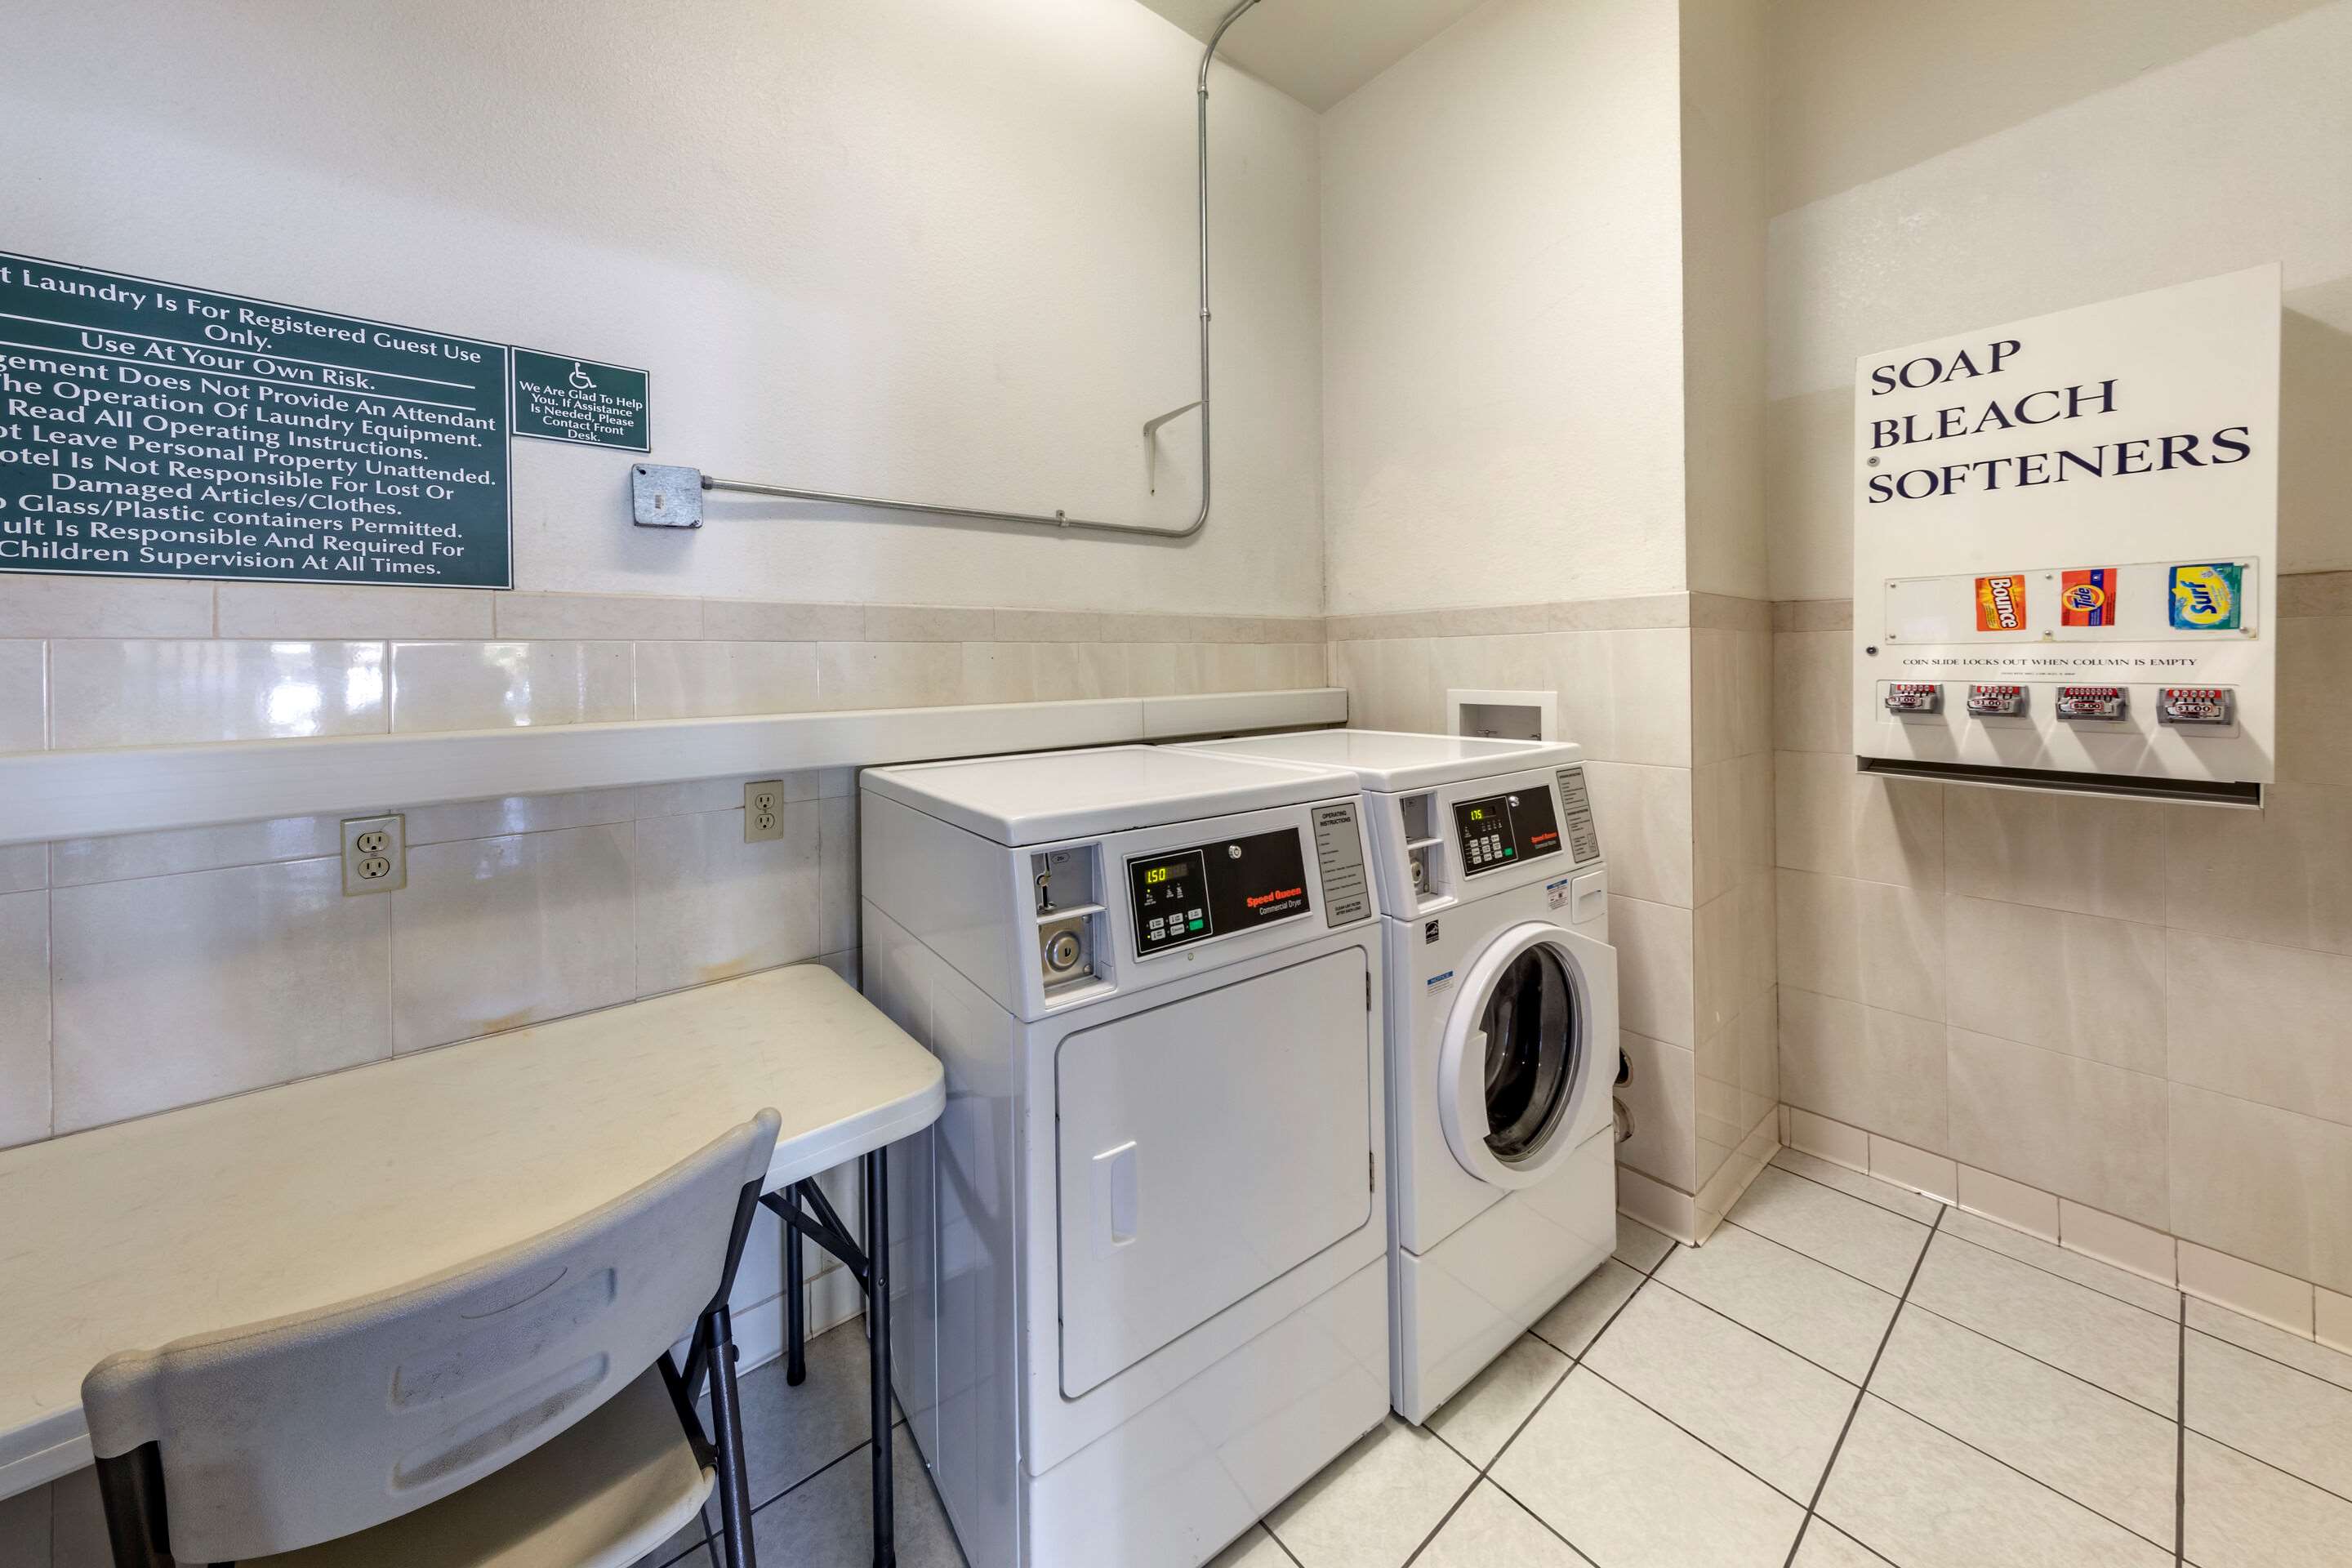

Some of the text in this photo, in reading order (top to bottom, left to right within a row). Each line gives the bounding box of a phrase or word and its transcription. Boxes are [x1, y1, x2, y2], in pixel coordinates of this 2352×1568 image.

[24, 270, 146, 310] Laundry
[157, 293, 177, 311] Is
[188, 299, 229, 320] For
[239, 308, 365, 343] Registered
[374, 333, 438, 356] Guest
[444, 345, 480, 363] Use
[205, 325, 271, 352] Only.
[82, 332, 375, 390] Use At Your Own Risk.
[1872, 339, 2021, 396] SOAP
[0, 373, 482, 447] he Operation Of Laundry Equipment.
[119, 367, 191, 390] Does
[202, 378, 251, 399] Not
[260, 386, 349, 412] Provide
[355, 400, 385, 416] An
[392, 405, 496, 430] Attendant
[519, 381, 643, 411] We Are Glad To Help
[531, 403, 634, 426] Is Needed, Please
[532, 394, 632, 416] You. If Assistance
[1870, 379, 2118, 450] BLEACH
[9, 399, 428, 460] Read All Operating Instructions.
[542, 416, 624, 435] Contact Front
[568, 430, 601, 442] Desk.
[33, 425, 118, 448] Leave
[129, 434, 243, 461] Personal
[254, 448, 358, 476] Property
[366, 460, 495, 485] Unattended.
[1869, 426, 2252, 504] SOFTENERS
[52, 474, 402, 514] Damaged Articles/Clothes.
[72, 452, 93, 469] Is
[105, 455, 159, 475] Not
[169, 461, 323, 488] Responsible
[332, 476, 368, 492] For
[376, 480, 420, 497] Lost
[426, 485, 454, 500] Or
[19, 495, 204, 522] Glass/Plastic
[214, 512, 343, 531] containers
[352, 518, 462, 538] Permitted.
[0, 540, 441, 574] Children Supervision At All Times.
[56, 519, 78, 537] Is
[91, 522, 256, 546] Responsible
[265, 532, 314, 549] And
[323, 536, 423, 556] Required
[432, 542, 464, 556] For
[1989, 577, 2017, 629] Bounce
[2072, 586, 2096, 609] Tide
[2180, 580, 2217, 614] Surf
[1247, 888, 1302, 908] Speed Queen
[1259, 899, 1302, 915] Commercial Dryer
